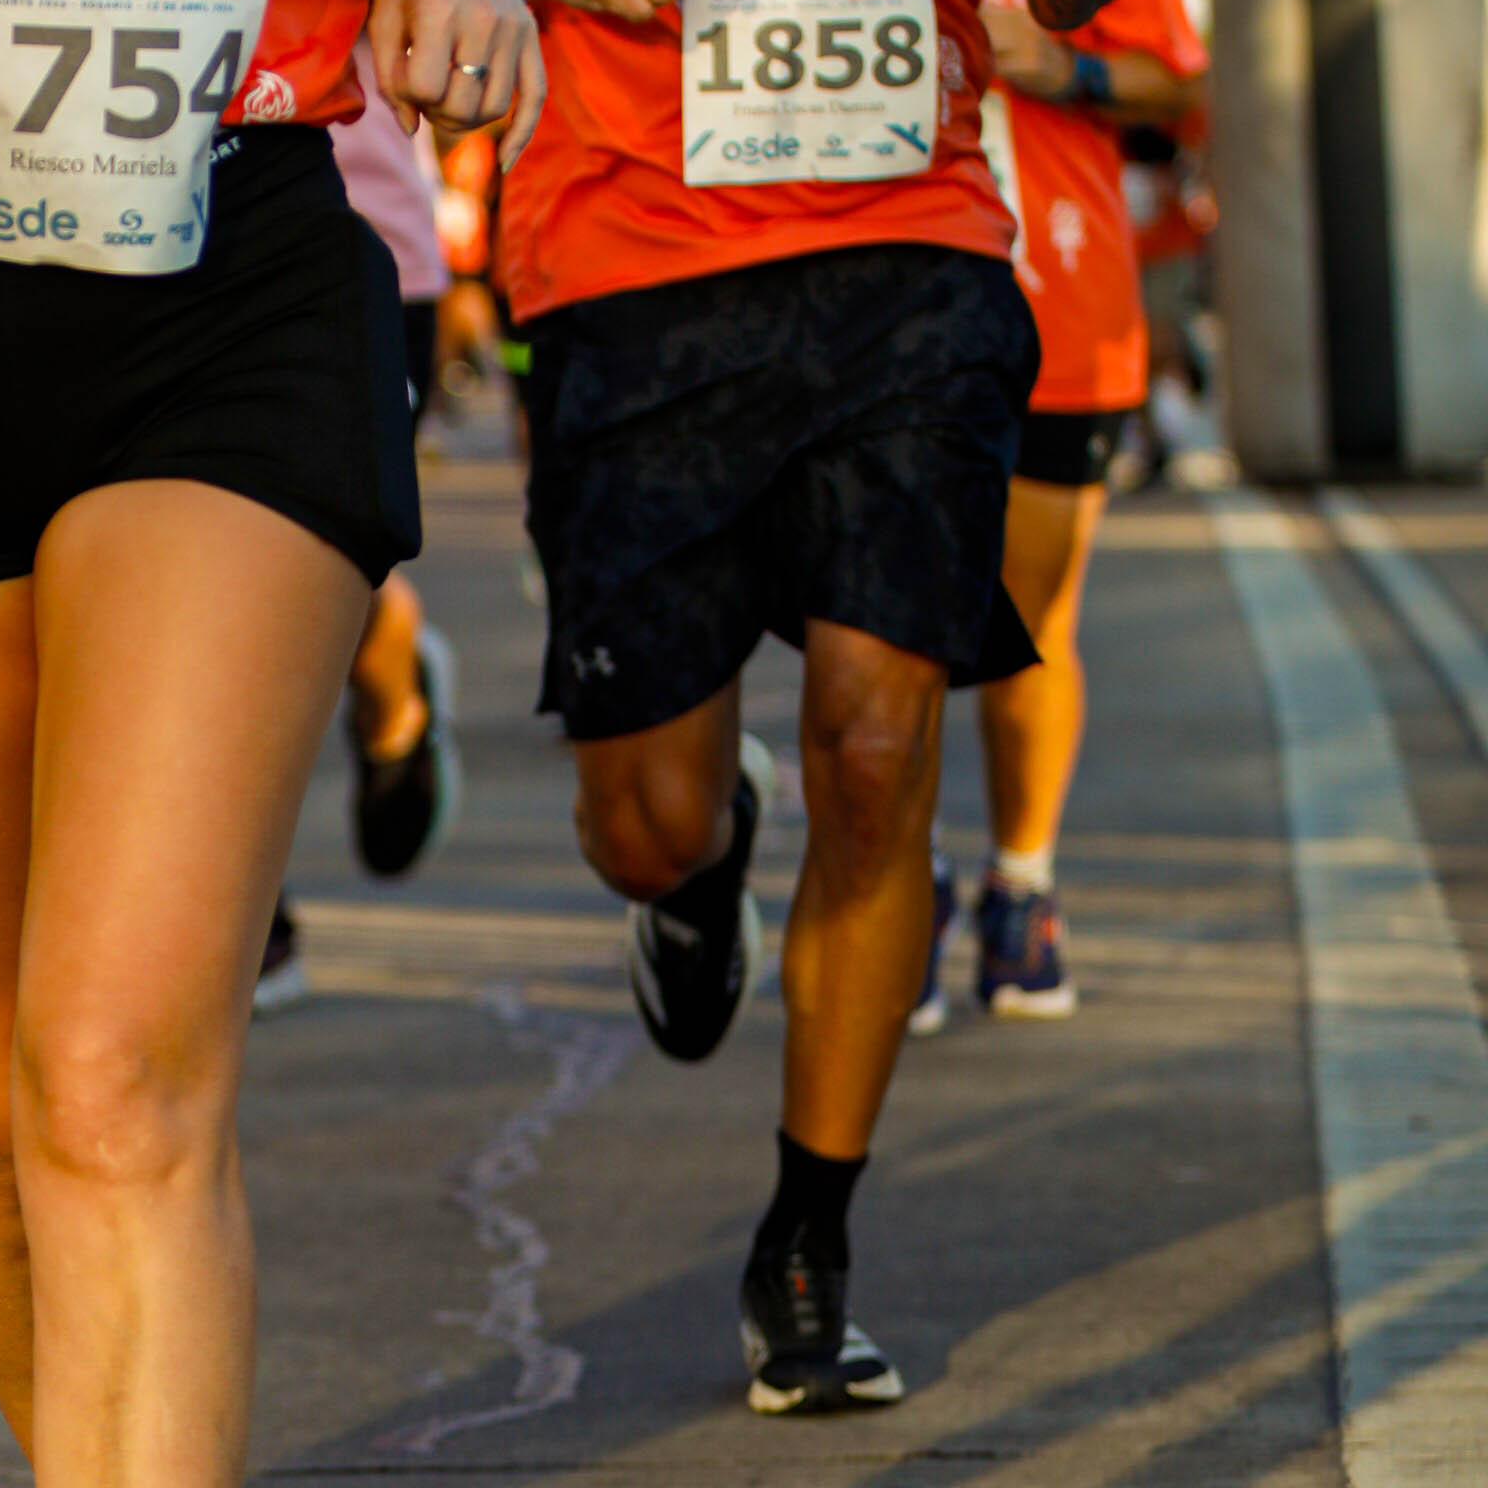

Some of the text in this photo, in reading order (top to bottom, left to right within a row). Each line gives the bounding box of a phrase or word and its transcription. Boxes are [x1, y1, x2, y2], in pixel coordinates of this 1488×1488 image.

[696, 14, 924, 91] 1858
[9, 147, 178, 177] Riesco Mariela
[721, 131, 801, 164] osde
